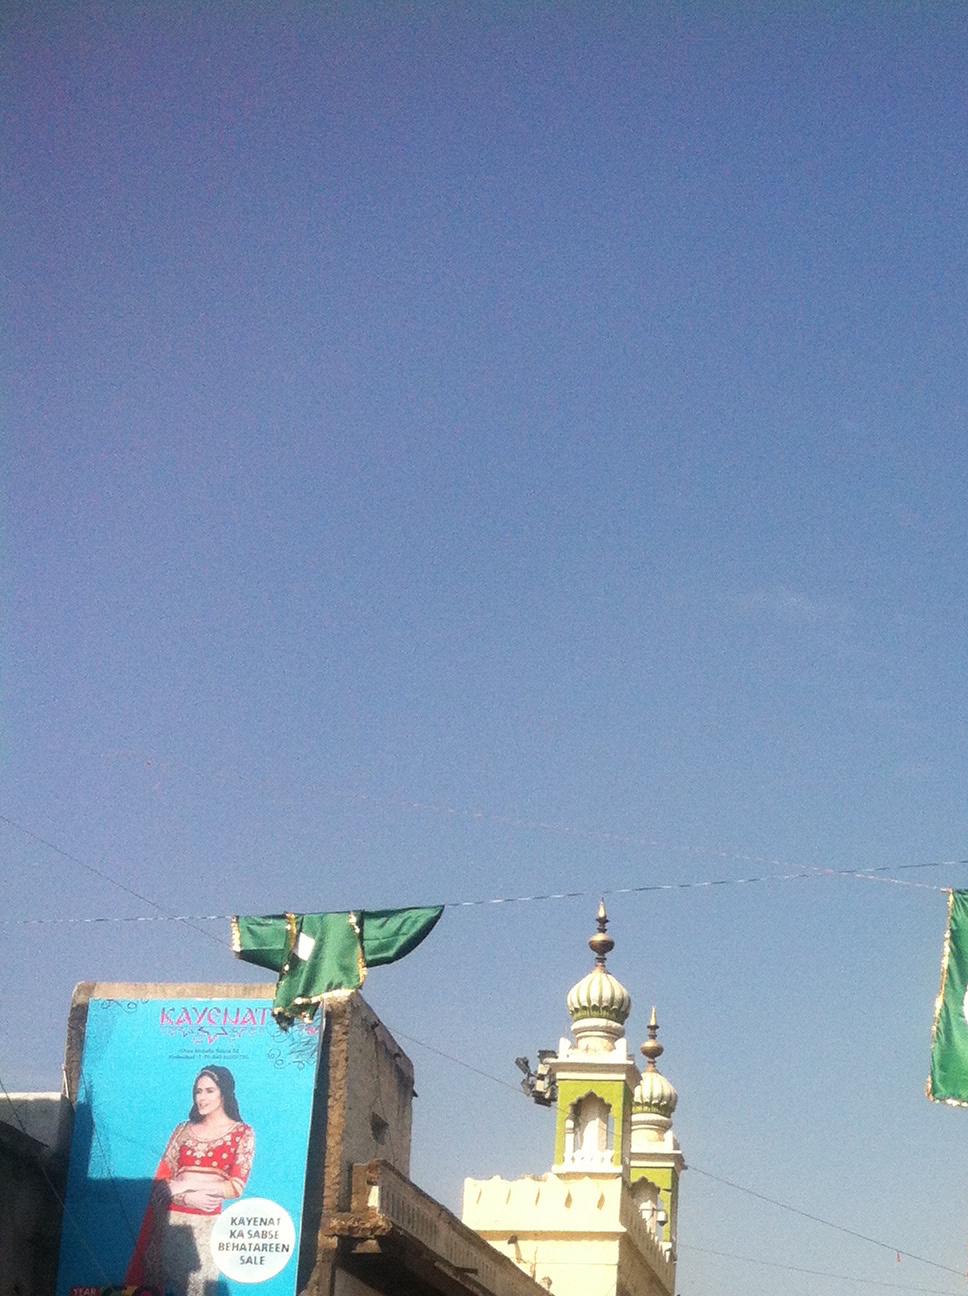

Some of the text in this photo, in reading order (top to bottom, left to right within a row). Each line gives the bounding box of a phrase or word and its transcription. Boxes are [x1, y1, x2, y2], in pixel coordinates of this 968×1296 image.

[230, 1216, 281, 1227] KAYENAT
[229, 1229, 279, 1240] KA SABSE
[218, 1242, 289, 1252] BEHATAREEN
[239, 1255, 265, 1266] SALE
